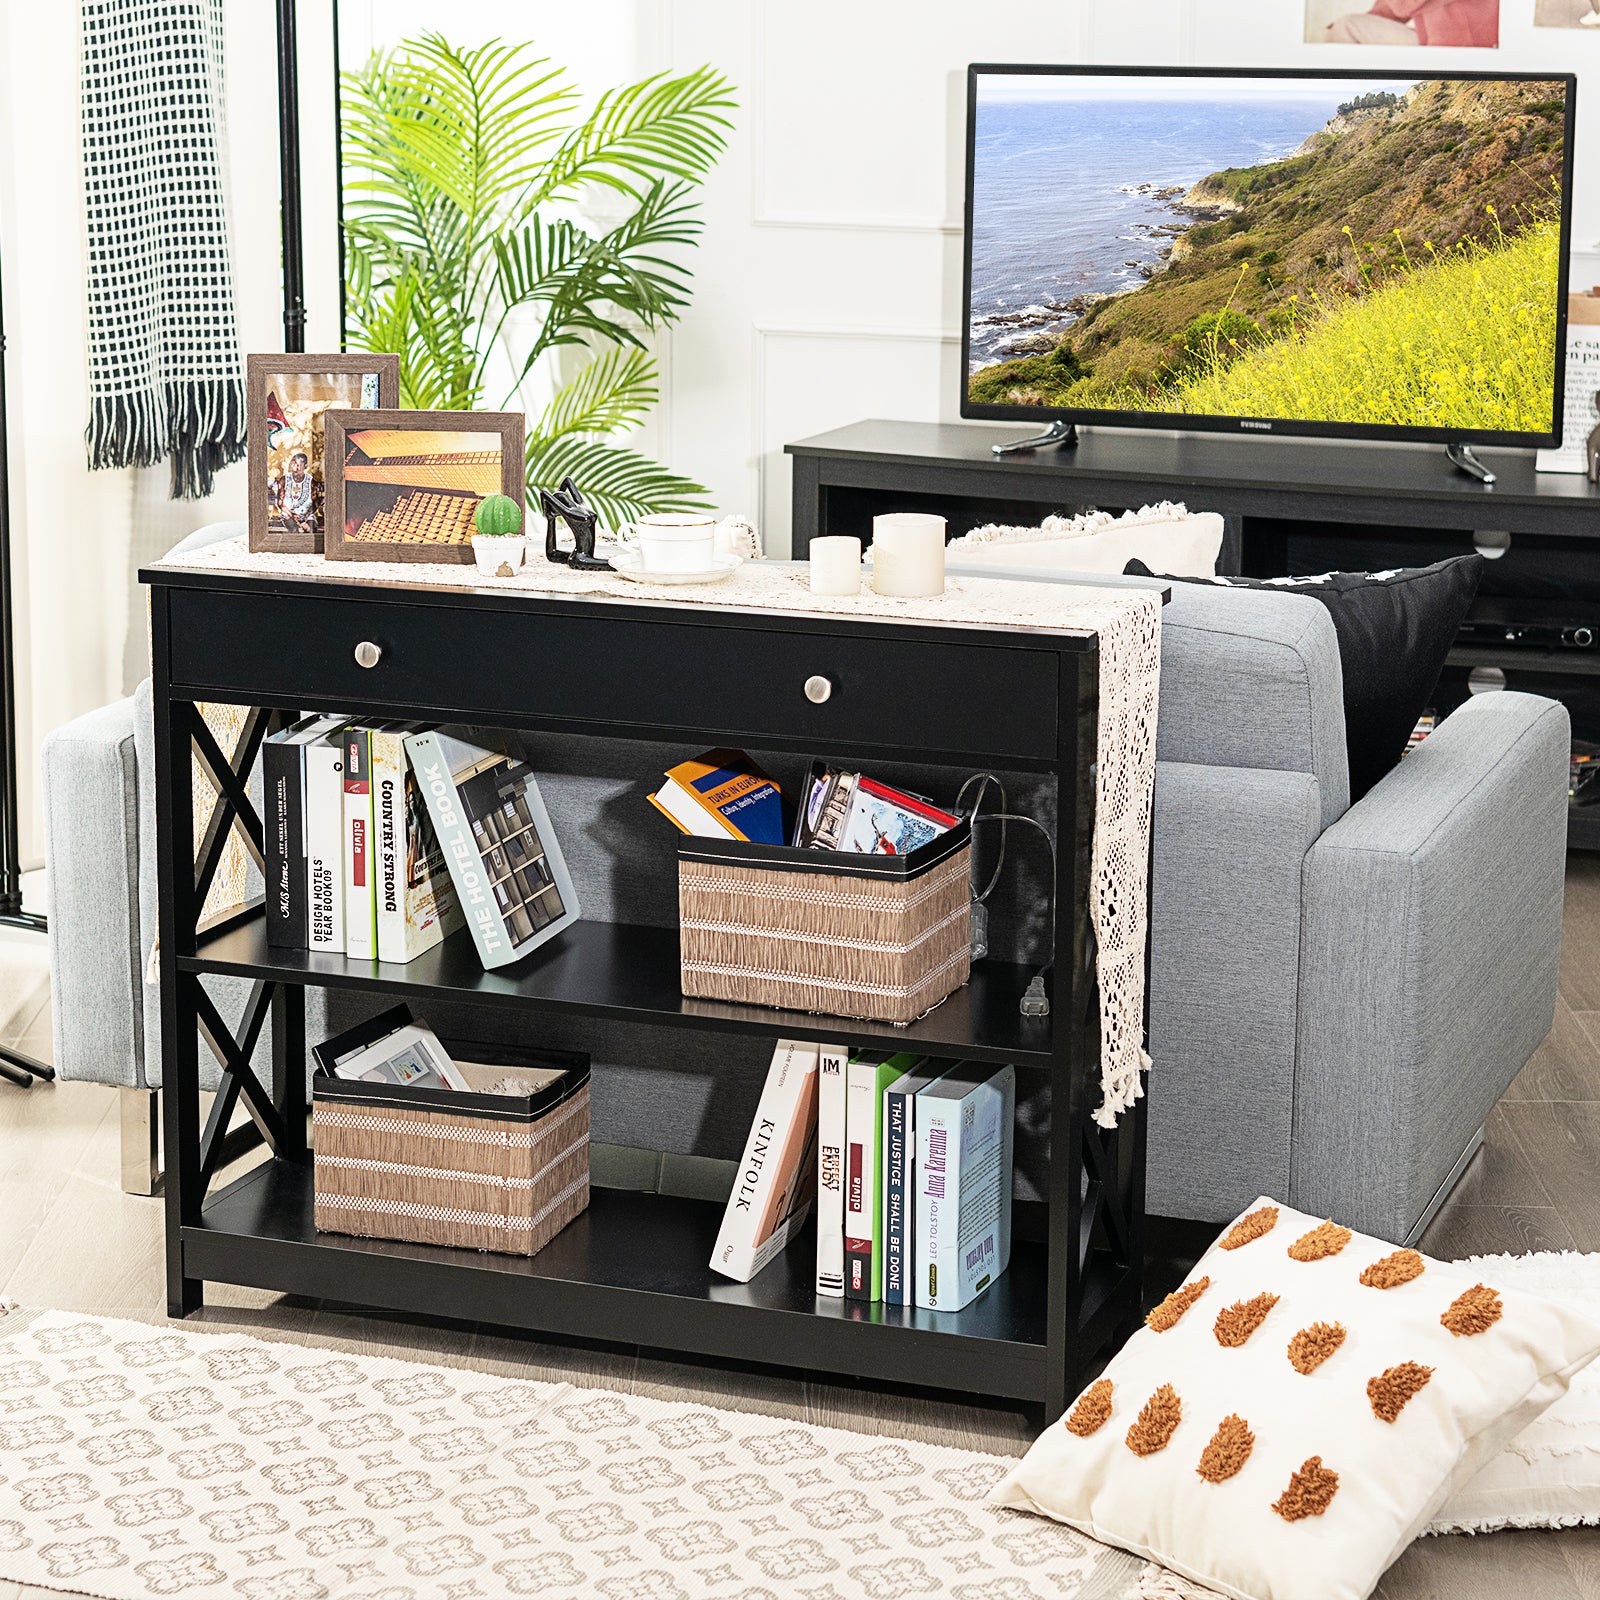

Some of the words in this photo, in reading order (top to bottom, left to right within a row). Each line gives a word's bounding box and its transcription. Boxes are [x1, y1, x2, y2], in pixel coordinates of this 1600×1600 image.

[424, 762, 459, 829] BOOK
[707, 790, 731, 804] TURKS
[728, 786, 740, 795] IN
[381, 779, 395, 851] COUNTRY
[353, 821, 364, 854] olivia
[313, 859, 323, 901] HOTELS
[384, 854, 398, 912] STRONG
[450, 831, 483, 905] HOTEL
[313, 903, 323, 942] DESIGN
[323, 913, 333, 943] YEAR
[474, 907, 502, 954] THE
[823, 1057, 840, 1073] IM
[891, 1102, 902, 1133] THAT
[736, 1118, 775, 1213] KINFOLK
[822, 1145, 833, 1191] ENJOY
[831, 1146, 840, 1192] PERFECT
[891, 1134, 902, 1187] JUSTICE
[924, 1128, 948, 1173] Karenina
[851, 1177, 862, 1210] olivia
[923, 1174, 945, 1199] Anna
[890, 1193, 900, 1232] SHALL
[930, 1200, 939, 1239] TOLSTOY
[890, 1235, 900, 1250] BE
[930, 1240, 938, 1259] LEO
[889, 1254, 900, 1291] DONE
